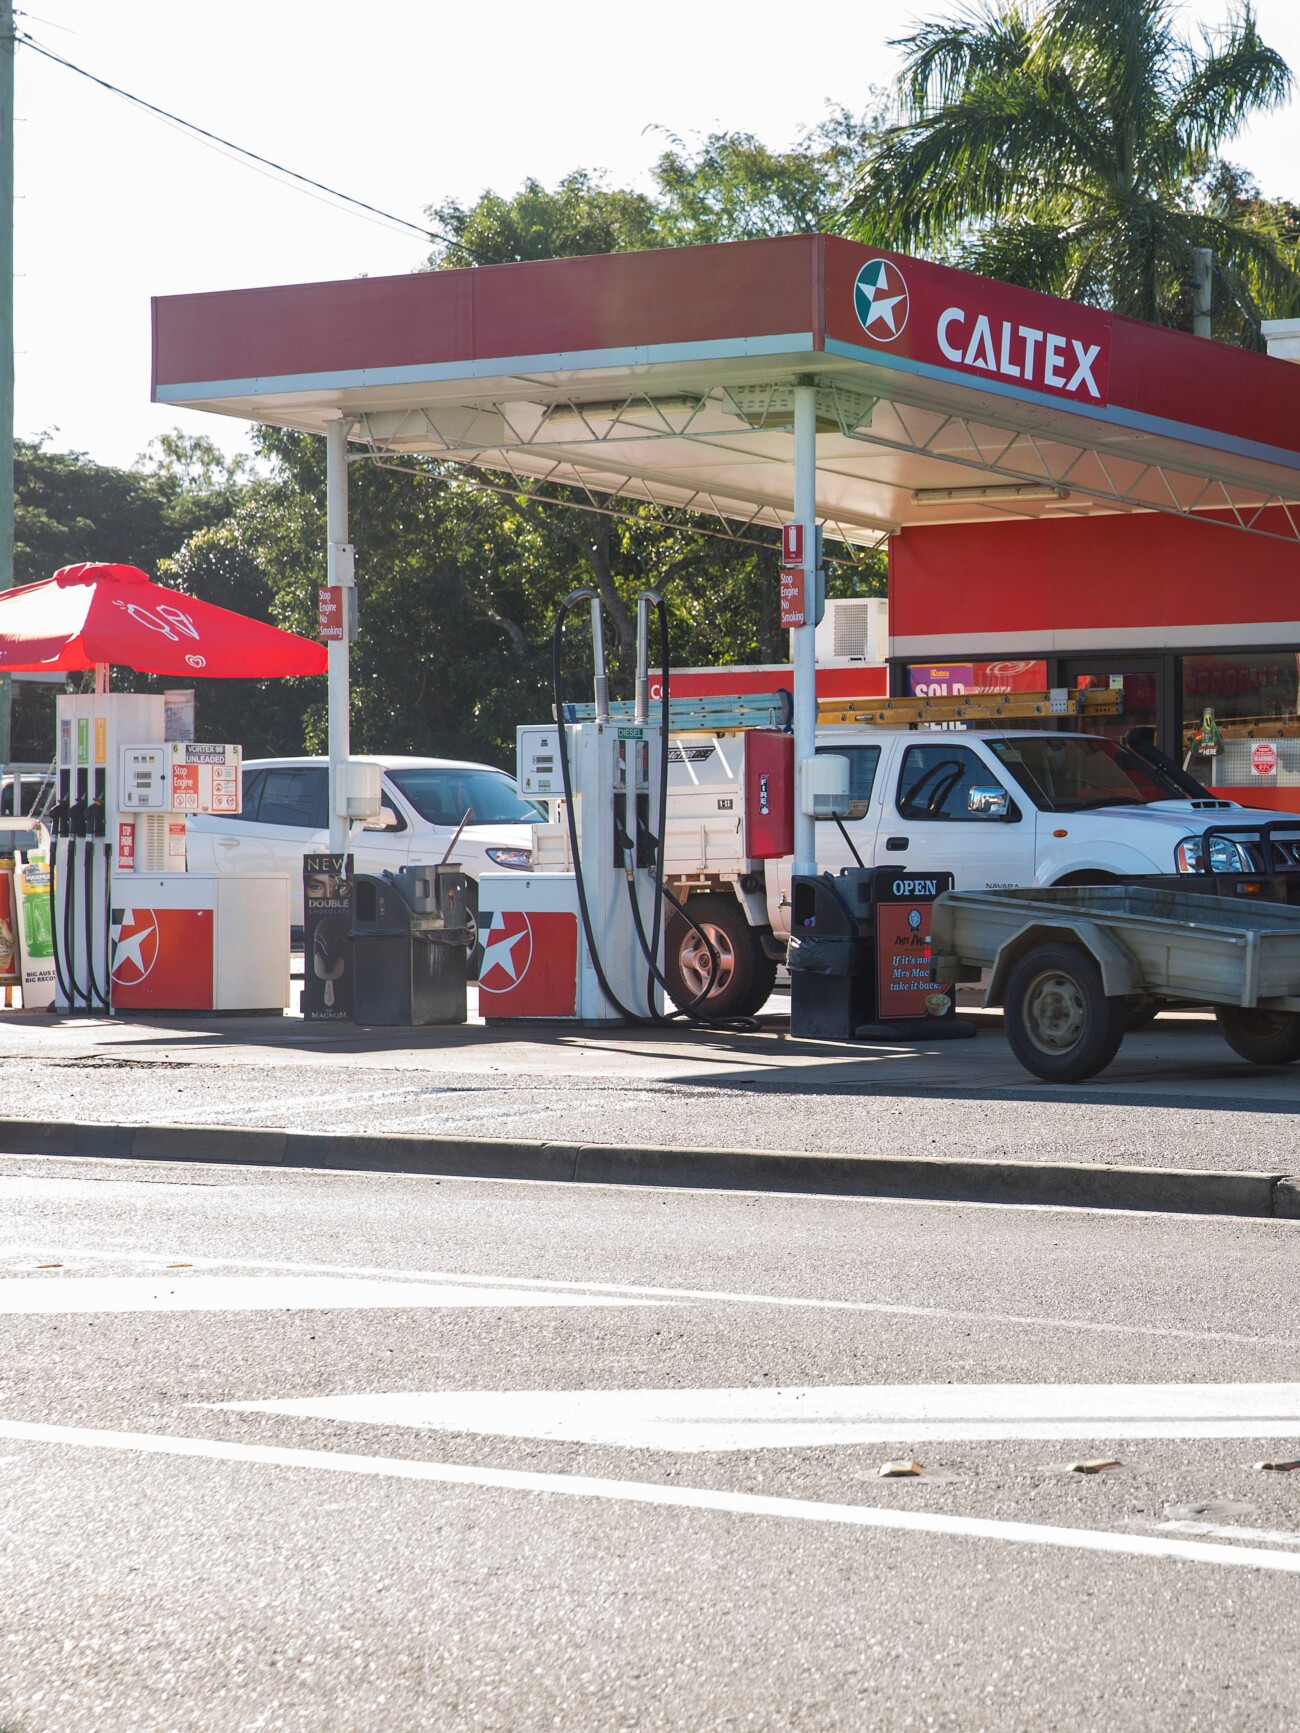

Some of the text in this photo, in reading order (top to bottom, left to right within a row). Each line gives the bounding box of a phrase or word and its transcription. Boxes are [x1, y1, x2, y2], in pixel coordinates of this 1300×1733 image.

[937, 307, 1101, 398] CALTEX
[781, 573, 793, 587] Stop
[319, 590, 332, 603] Stop
[781, 586, 799, 599] Engine
[320, 602, 337, 615] Engine
[782, 600, 790, 609] No
[320, 614, 328, 624] No
[782, 611, 804, 624] Smoking
[320, 625, 343, 638] Smoking
[618, 728, 642, 737] DIESEL
[172, 744, 178, 752] 6
[186, 755, 225, 764] UNLEADED
[174, 765, 188, 778] Stop
[174, 779, 193, 790] Engine
[122, 826, 132, 835] STOP
[120, 836, 133, 846] ENGINE
[119, 857, 134, 865] SMOKING
[893, 880, 937, 896] OPEN
[308, 899, 349, 908] DOUBLE
[892, 956, 900, 966] If
[902, 956, 915, 964] it's
[893, 969, 930, 978] Mrs Mac
[890, 982, 909, 990] take
[910, 982, 917, 990] it
